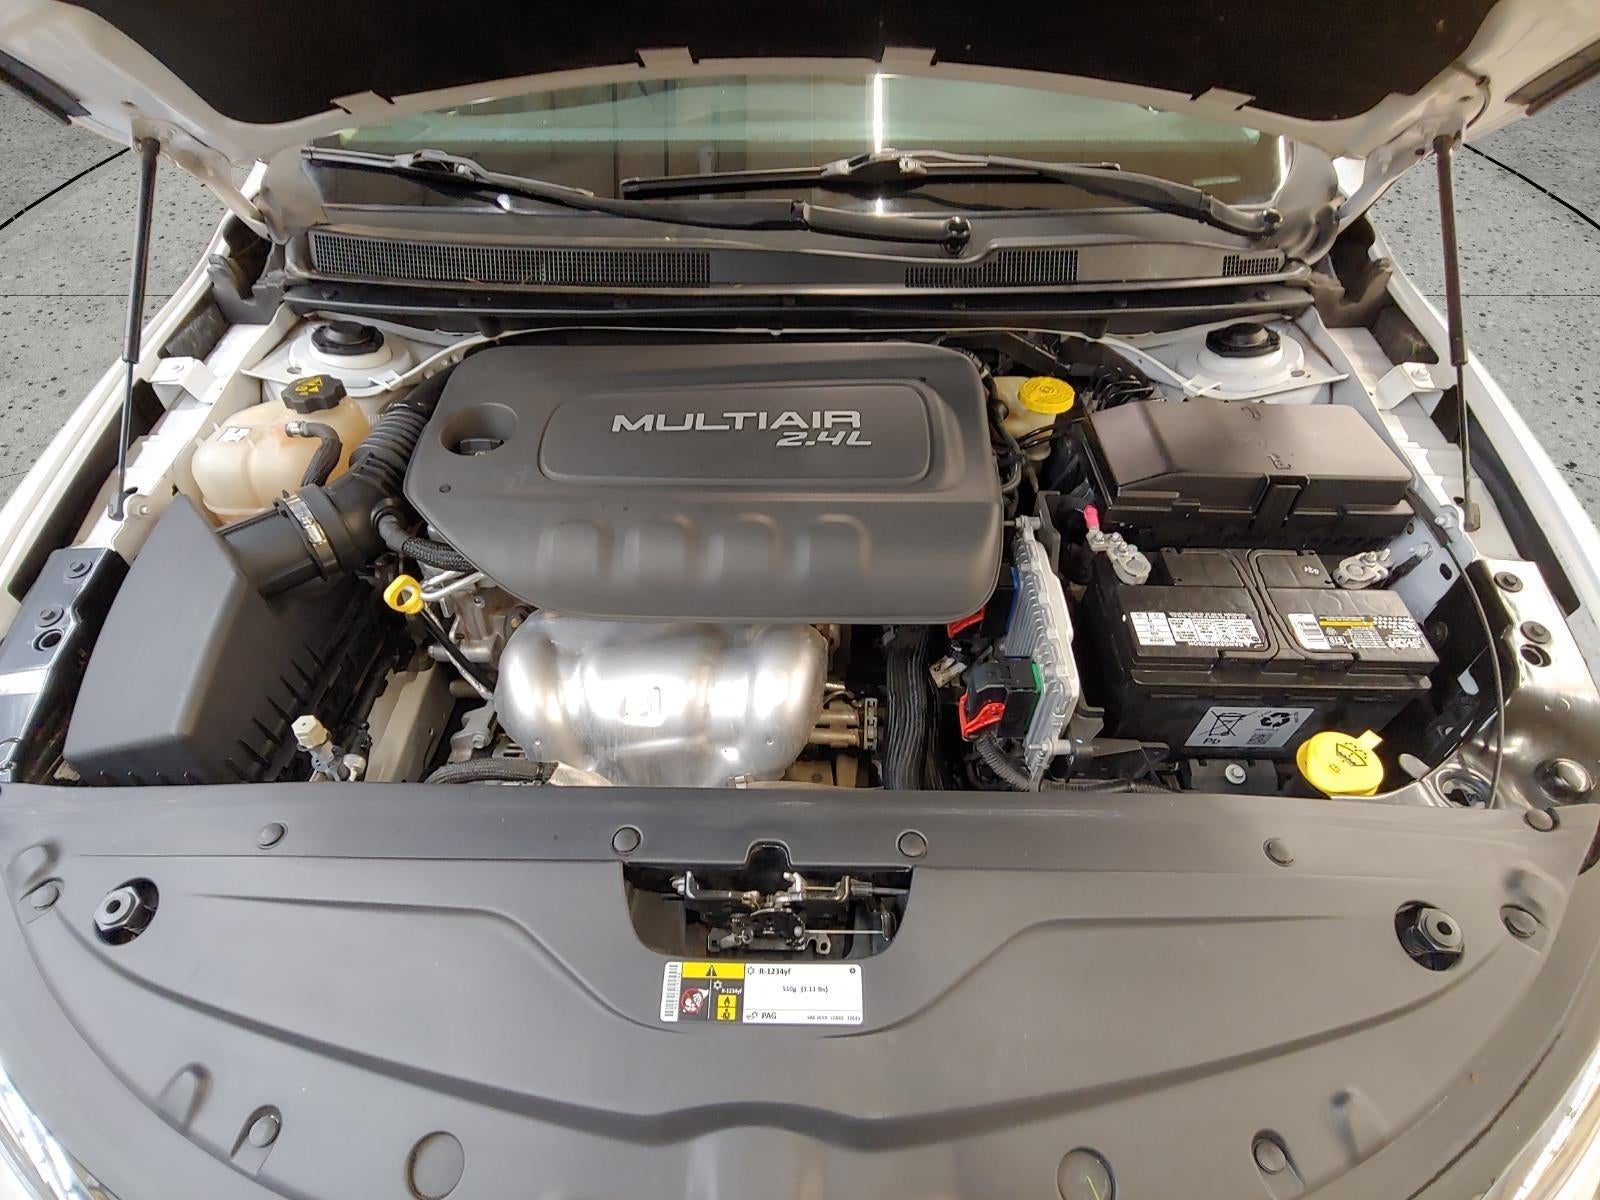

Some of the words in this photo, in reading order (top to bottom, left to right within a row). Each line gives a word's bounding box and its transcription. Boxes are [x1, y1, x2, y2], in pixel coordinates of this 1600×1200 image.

[611, 410, 861, 432] MULTIAIR
[775, 430, 872, 447] 2.4L
[1203, 737, 1221, 745] Pb
[759, 967, 791, 976] R-1234yf
[761, 1012, 777, 1020] PAG
